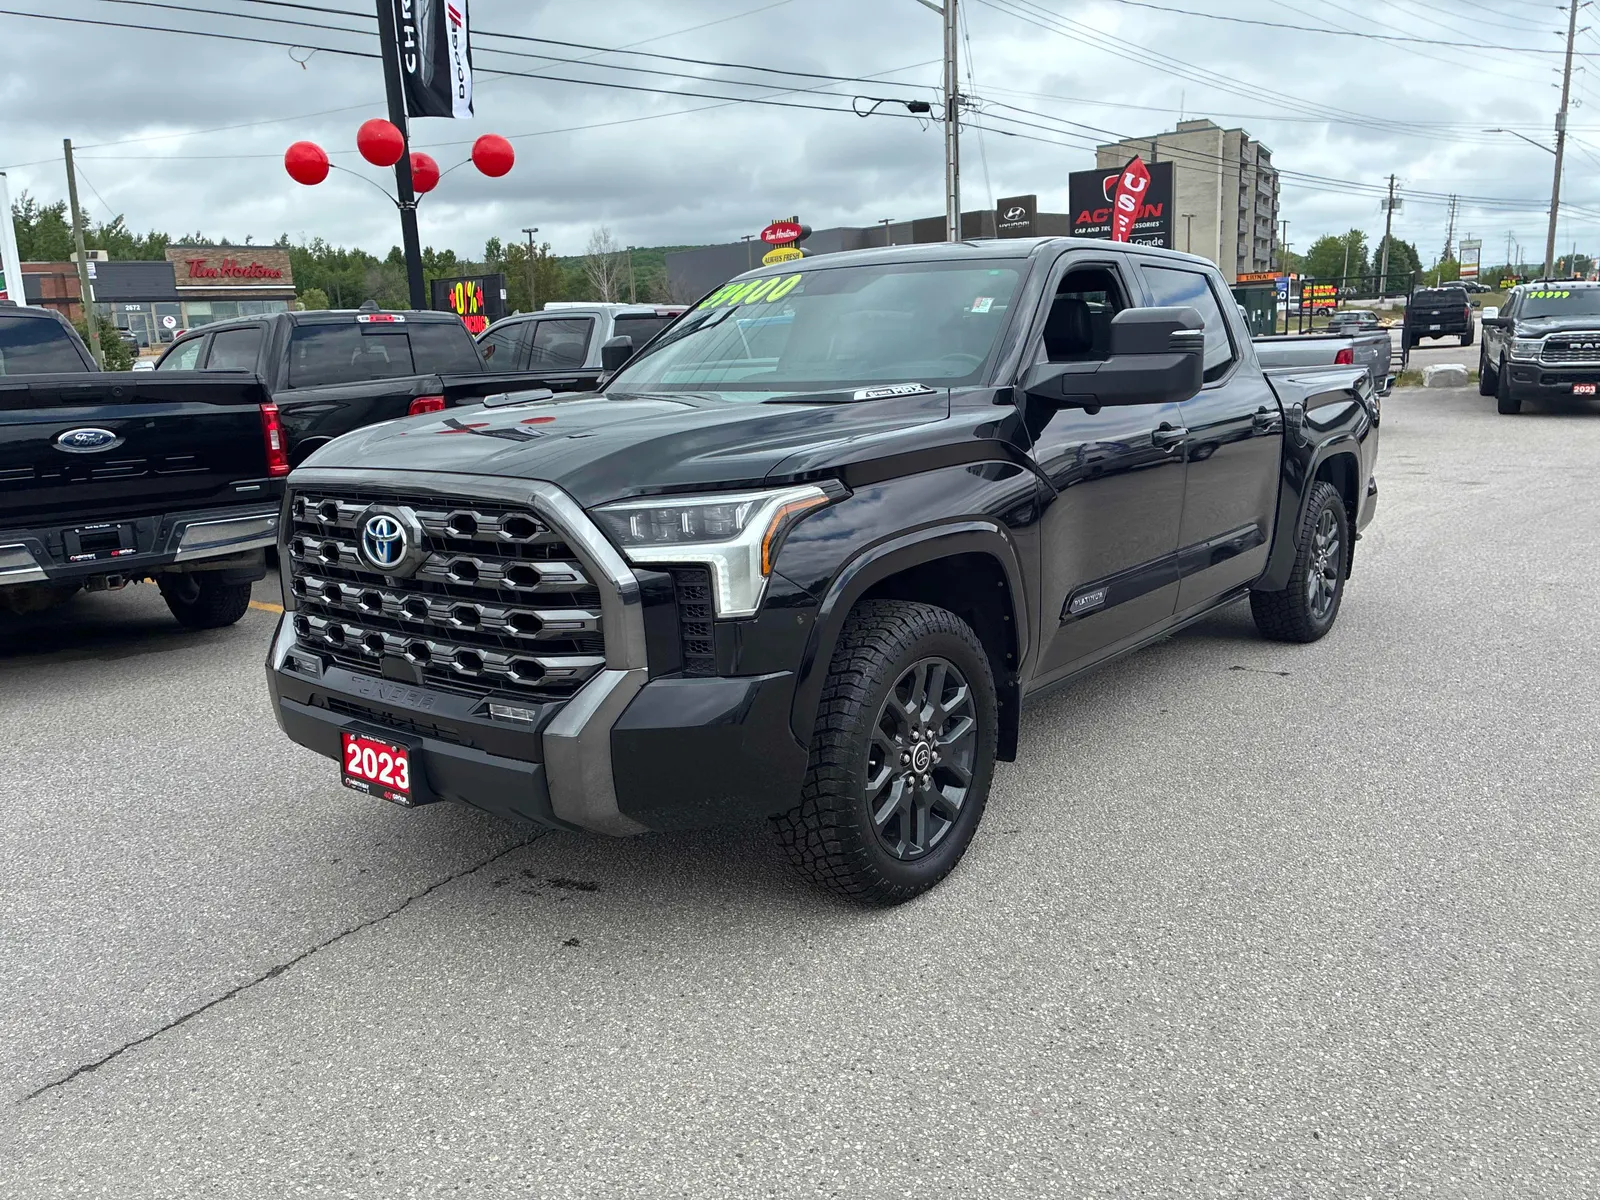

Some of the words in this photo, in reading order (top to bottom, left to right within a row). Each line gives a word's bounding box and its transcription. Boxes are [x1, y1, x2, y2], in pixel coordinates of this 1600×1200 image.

[765, 230, 775, 240] Tim
[776, 229, 797, 239] Hortons
[783, 252, 800, 261] FRESH
[185, 258, 218, 278] Tim
[219, 258, 282, 278] Hortons
[1573, 385, 1596, 393] 2023
[73, 432, 104, 446] Ford
[1074, 591, 1103, 605] PLATINUM
[347, 743, 410, 789] 2023
